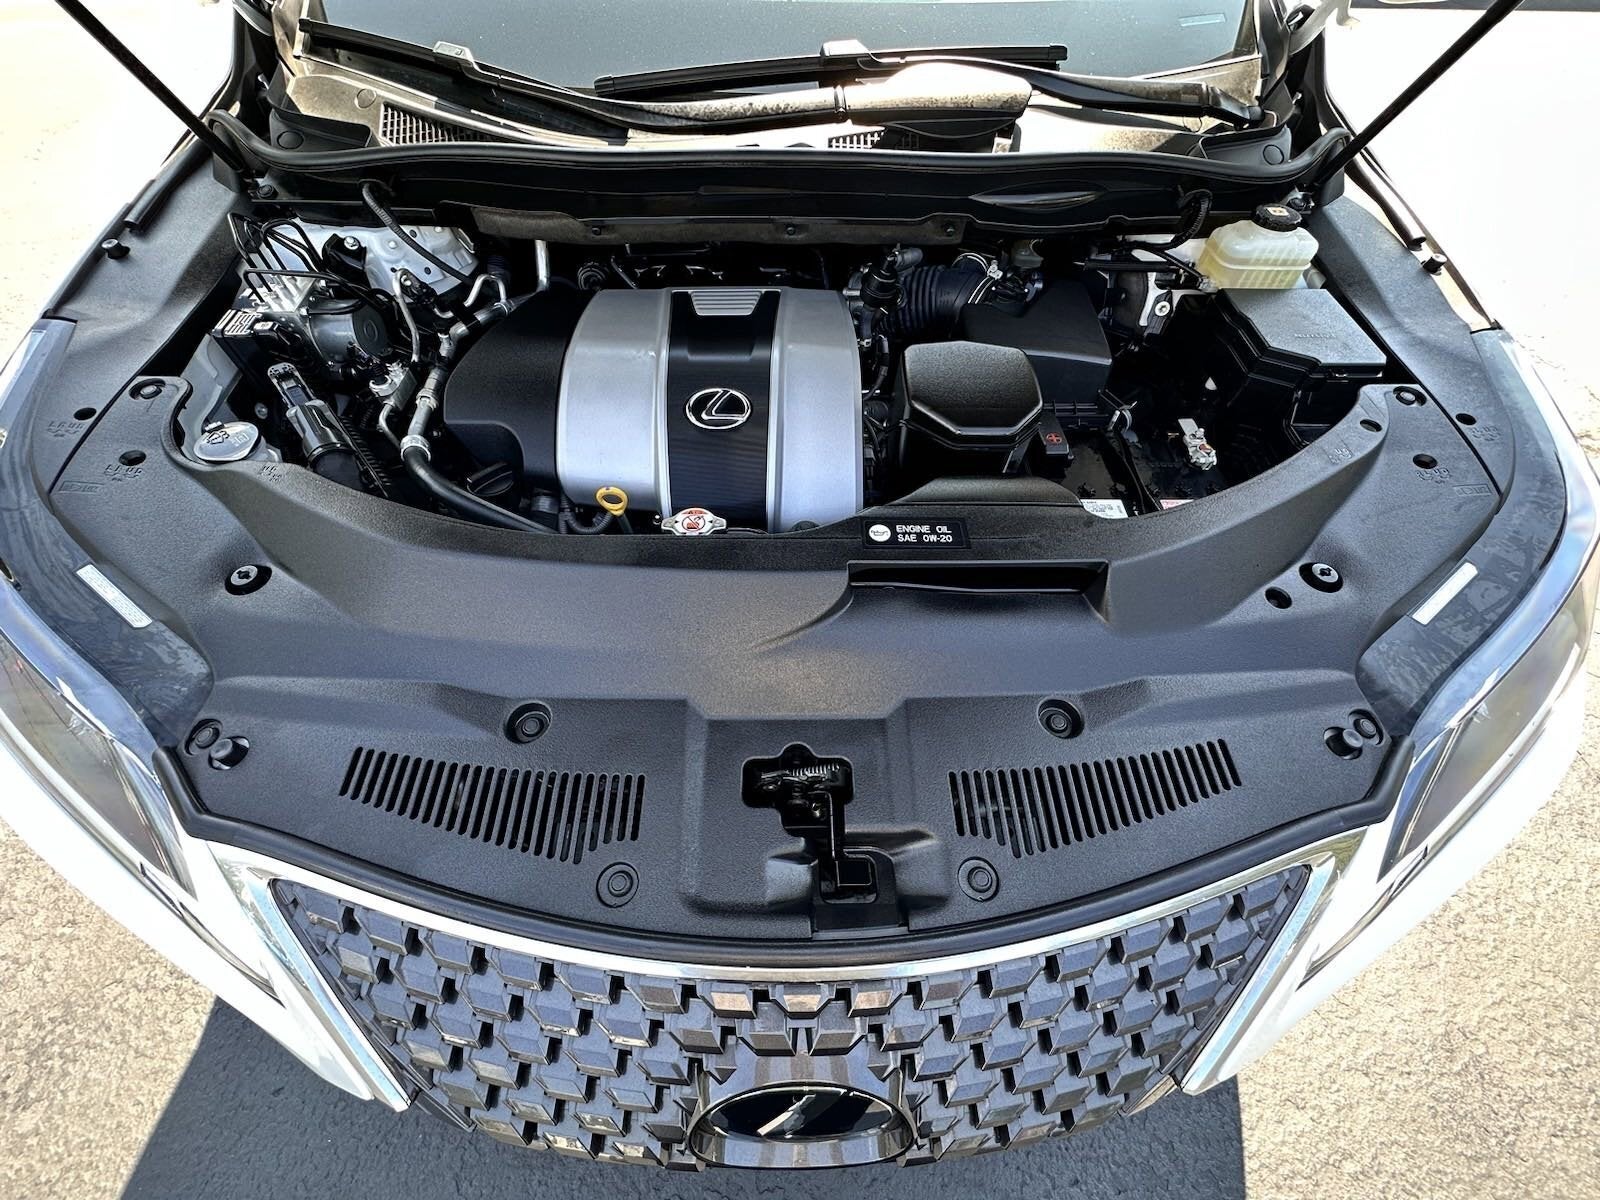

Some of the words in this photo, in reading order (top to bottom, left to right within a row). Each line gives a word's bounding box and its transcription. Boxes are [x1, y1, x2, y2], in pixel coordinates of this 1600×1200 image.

[895, 524, 931, 533] ENGINE
[935, 525, 952, 533] OIL
[897, 534, 917, 542] SAE
[922, 534, 953, 543] 0W-20
